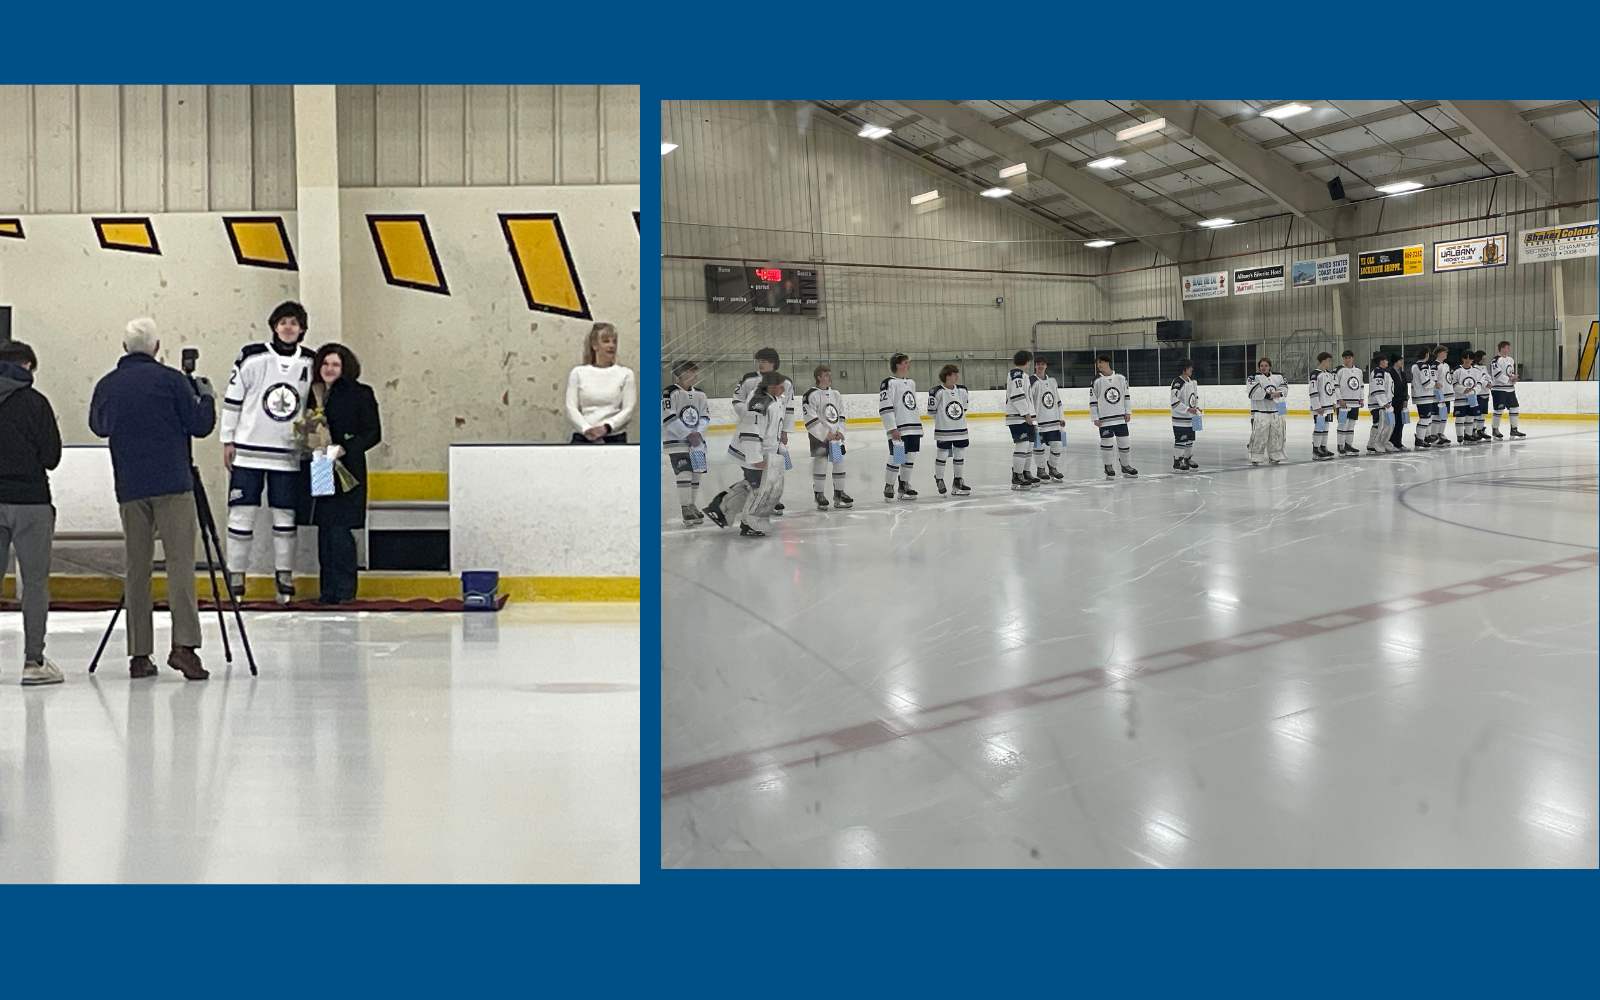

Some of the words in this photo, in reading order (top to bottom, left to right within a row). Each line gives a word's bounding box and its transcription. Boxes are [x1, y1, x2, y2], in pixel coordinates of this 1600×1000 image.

[1526, 231, 1559, 242] Shaker
[1561, 226, 1598, 238] Colonie
[1441, 247, 1476, 258] UALBANY
[1525, 247, 1552, 255] SECTION
[1559, 241, 1598, 251] CHAMPIONS
[1317, 261, 1331, 269] UNITED
[1333, 259, 1348, 267] STATES
[1360, 265, 1383, 275] LOCKSMITH
[299, 366, 308, 382] A
